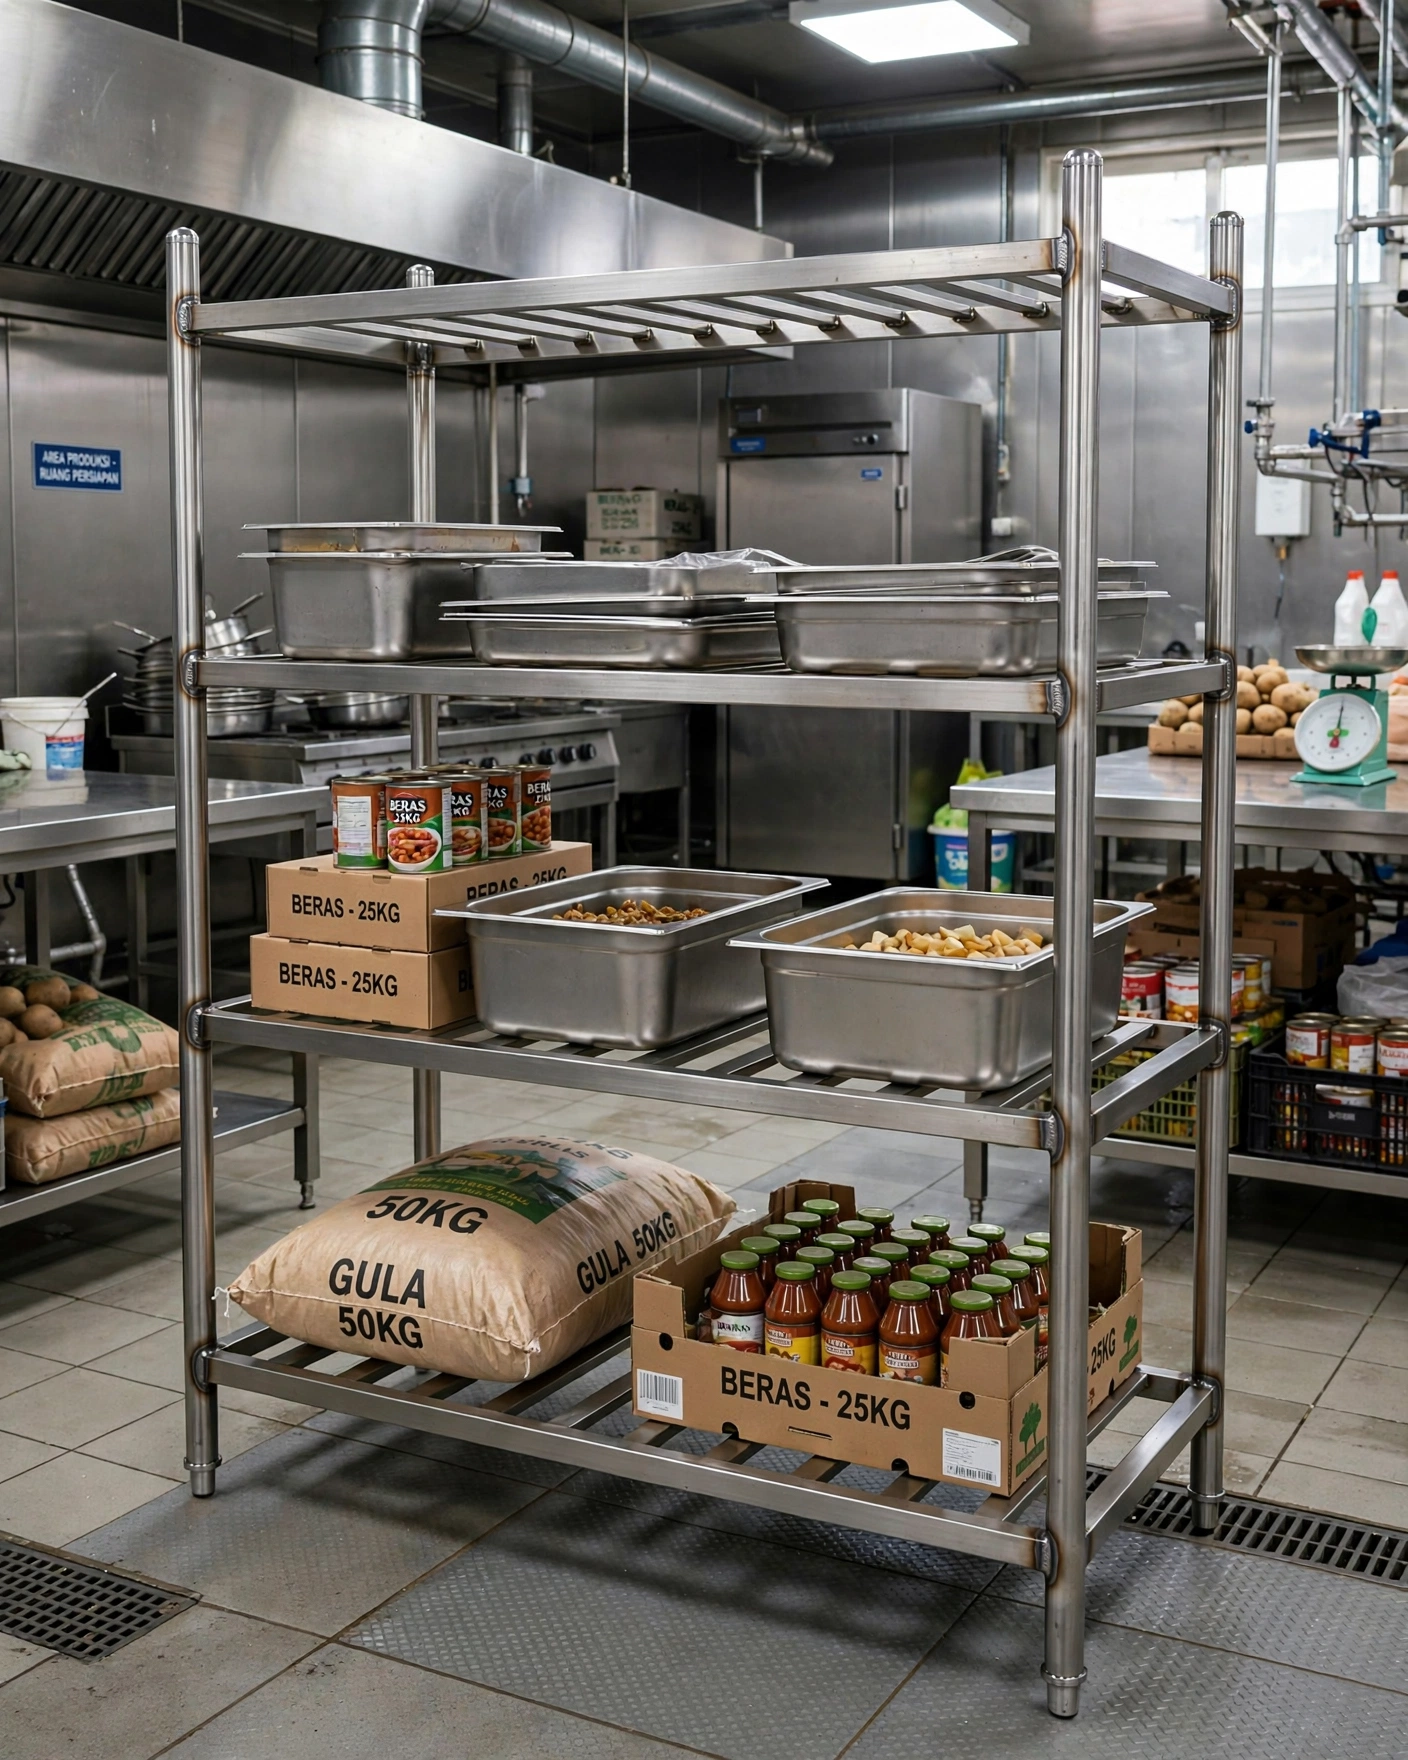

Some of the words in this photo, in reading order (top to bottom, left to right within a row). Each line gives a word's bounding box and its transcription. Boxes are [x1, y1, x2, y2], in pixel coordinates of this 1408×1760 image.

[42, 450, 65, 464] AREA
[66, 452, 111, 468] PRODUKSI
[72, 469, 119, 484] PERSIAPAN
[389, 799, 427, 813] BERAS
[451, 794, 473, 807] RAS
[291, 893, 344, 918] BERAS
[358, 900, 400, 923] 25KG
[279, 962, 336, 989] BERAS
[352, 971, 398, 997] 25KG
[366, 1195, 489, 1234] 50KG
[577, 1239, 632, 1294] GULA
[632, 1211, 676, 1259] 50KG
[328, 1258, 426, 1309] GULA
[339, 1306, 423, 1349] 50KG
[1090, 1327, 1116, 1376] 25KG
[721, 1366, 811, 1411] BERAS
[820, 1399, 829, 1408] -
[837, 1390, 911, 1430] 25KG
